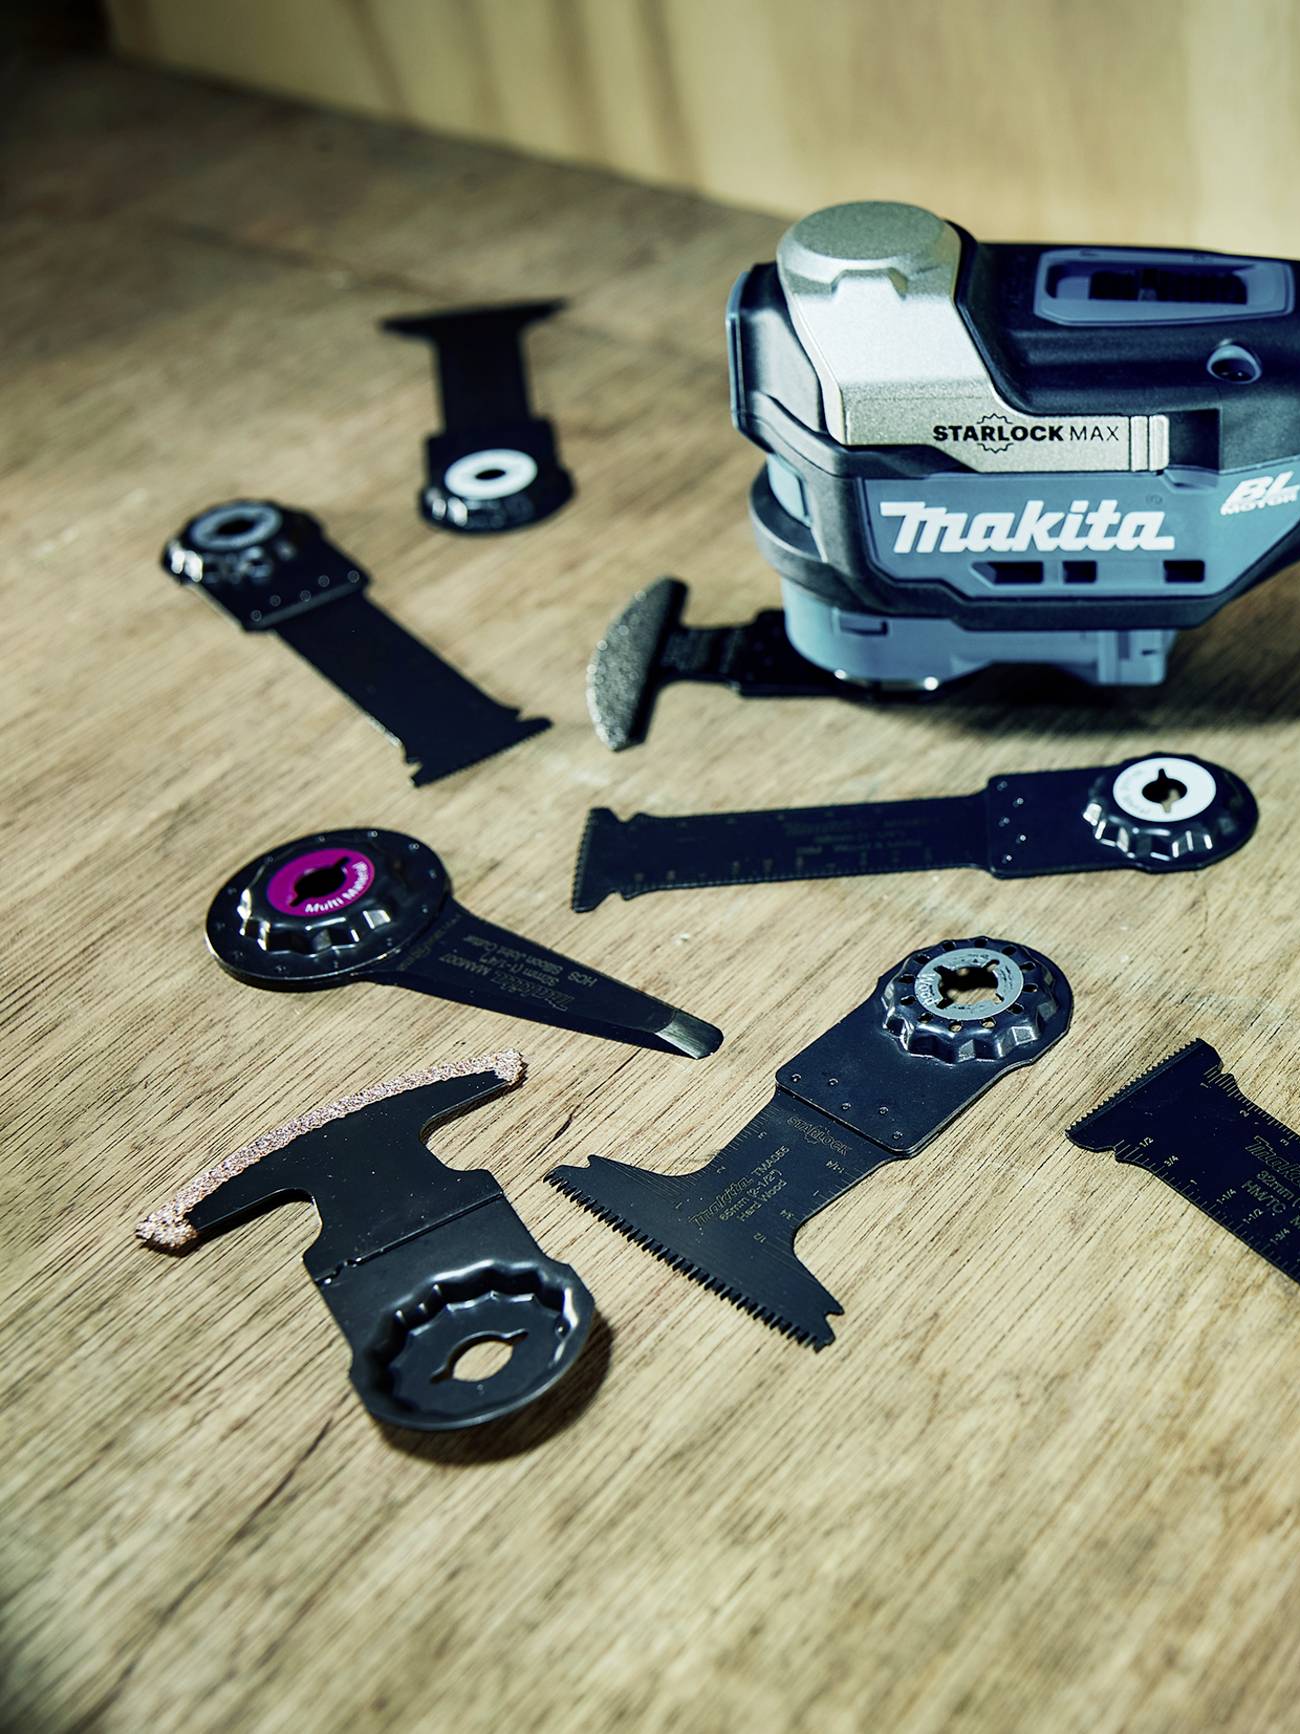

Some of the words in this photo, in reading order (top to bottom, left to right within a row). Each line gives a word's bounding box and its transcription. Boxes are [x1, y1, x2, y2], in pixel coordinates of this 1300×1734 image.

[932, 424, 1063, 443] STARLOCK
[1069, 424, 1119, 442] MAX
[1226, 471, 1300, 501] BL
[305, 896, 345, 914] Multi
[1256, 1169, 1295, 1201] 32mm
